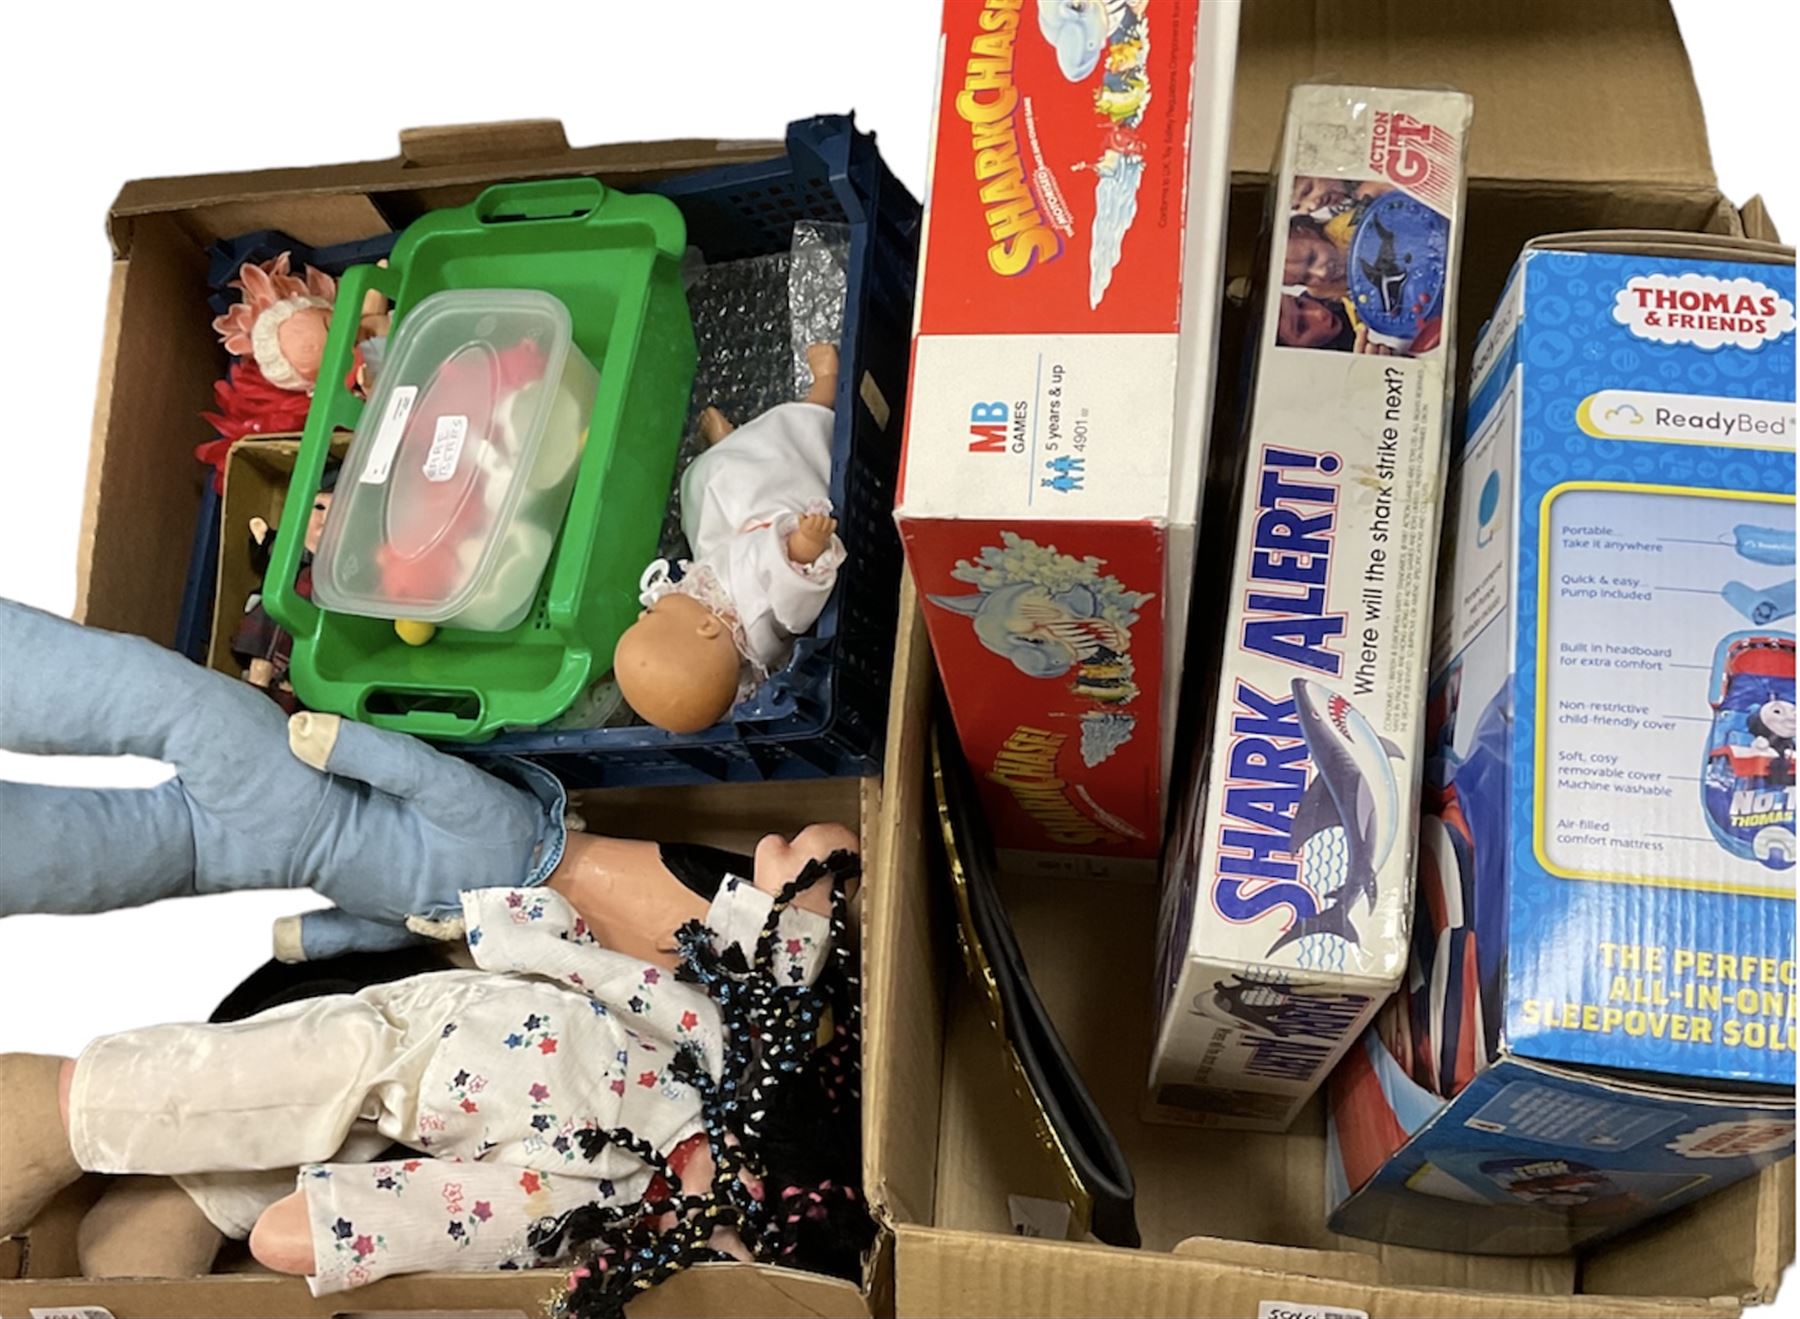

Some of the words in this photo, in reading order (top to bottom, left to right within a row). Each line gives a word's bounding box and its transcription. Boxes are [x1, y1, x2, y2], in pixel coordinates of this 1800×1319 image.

[1369, 110, 1389, 175] ACTION
[1386, 113, 1431, 186] GT
[1632, 288, 1776, 317] THOMAS
[1644, 311, 1662, 327] &
[1667, 313, 1767, 334] FRIENDS
[1052, 364, 1066, 384] up
[1048, 386, 1061, 398] &
[1384, 367, 1405, 421] next?
[968, 401, 1009, 453] MB
[1011, 400, 1028, 454] GAMES
[1048, 400, 1062, 440] years
[1656, 408, 1785, 436] ReadyBed
[1045, 442, 1058, 451] 5
[1073, 420, 1088, 452] 4901
[1376, 428, 1398, 480] strike
[1369, 486, 1393, 543] shark
[1563, 539, 1590, 548] Take
[1593, 540, 1601, 548] it
[1604, 541, 1664, 552] anywhere
[1239, 443, 1349, 679] ALERT!
[1365, 549, 1387, 581] the
[1561, 575, 1595, 586] Quick
[1599, 576, 1609, 585] &
[1561, 588, 1597, 599] Pump
[1600, 589, 1653, 601] included
[1363, 588, 1383, 621] will
[1354, 628, 1379, 696] Where
[1560, 643, 1588, 653] Built
[1591, 644, 1603, 653] in
[1606, 644, 1672, 658] headboard
[1560, 656, 1578, 666] for
[1581, 657, 1611, 667] extra
[1614, 658, 1663, 671] comfort
[1642, 720, 1676, 731] cover
[1558, 766, 1625, 779] removable
[1627, 771, 1661, 781] cover
[1590, 753, 1618, 766] cosy
[1558, 779, 1611, 791] Machine
[1614, 783, 1673, 797] washable
[1212, 677, 1321, 932] SHARK
[1731, 811, 1794, 828] THOMAS
[1557, 833, 1607, 846] comfort
[1610, 837, 1664, 851] mattress
[1600, 942, 1663, 973] THE
[1522, 998, 1713, 1044] SLEEPOVER
